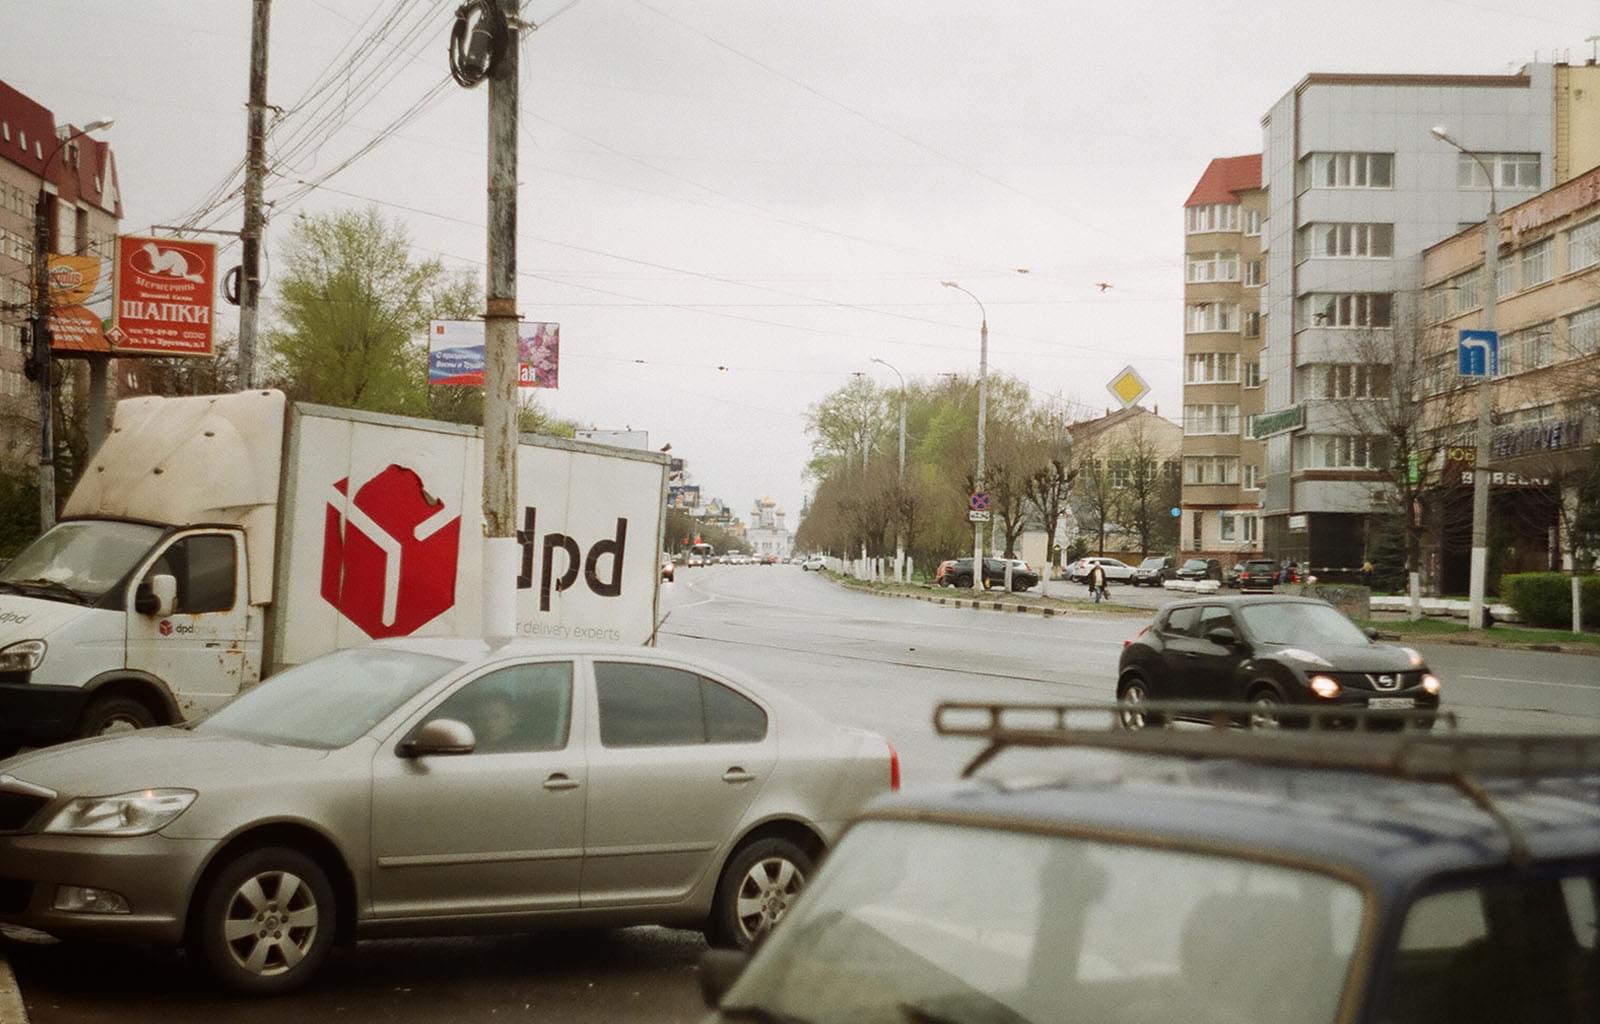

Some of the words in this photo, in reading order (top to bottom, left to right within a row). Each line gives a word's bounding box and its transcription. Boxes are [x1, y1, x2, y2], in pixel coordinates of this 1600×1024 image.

[121, 300, 209, 324] ШАПКИ
[517, 363, 536, 382] ая
[176, 623, 194, 635] dpd
[523, 621, 571, 638] delivery
[574, 625, 620, 641] experts
